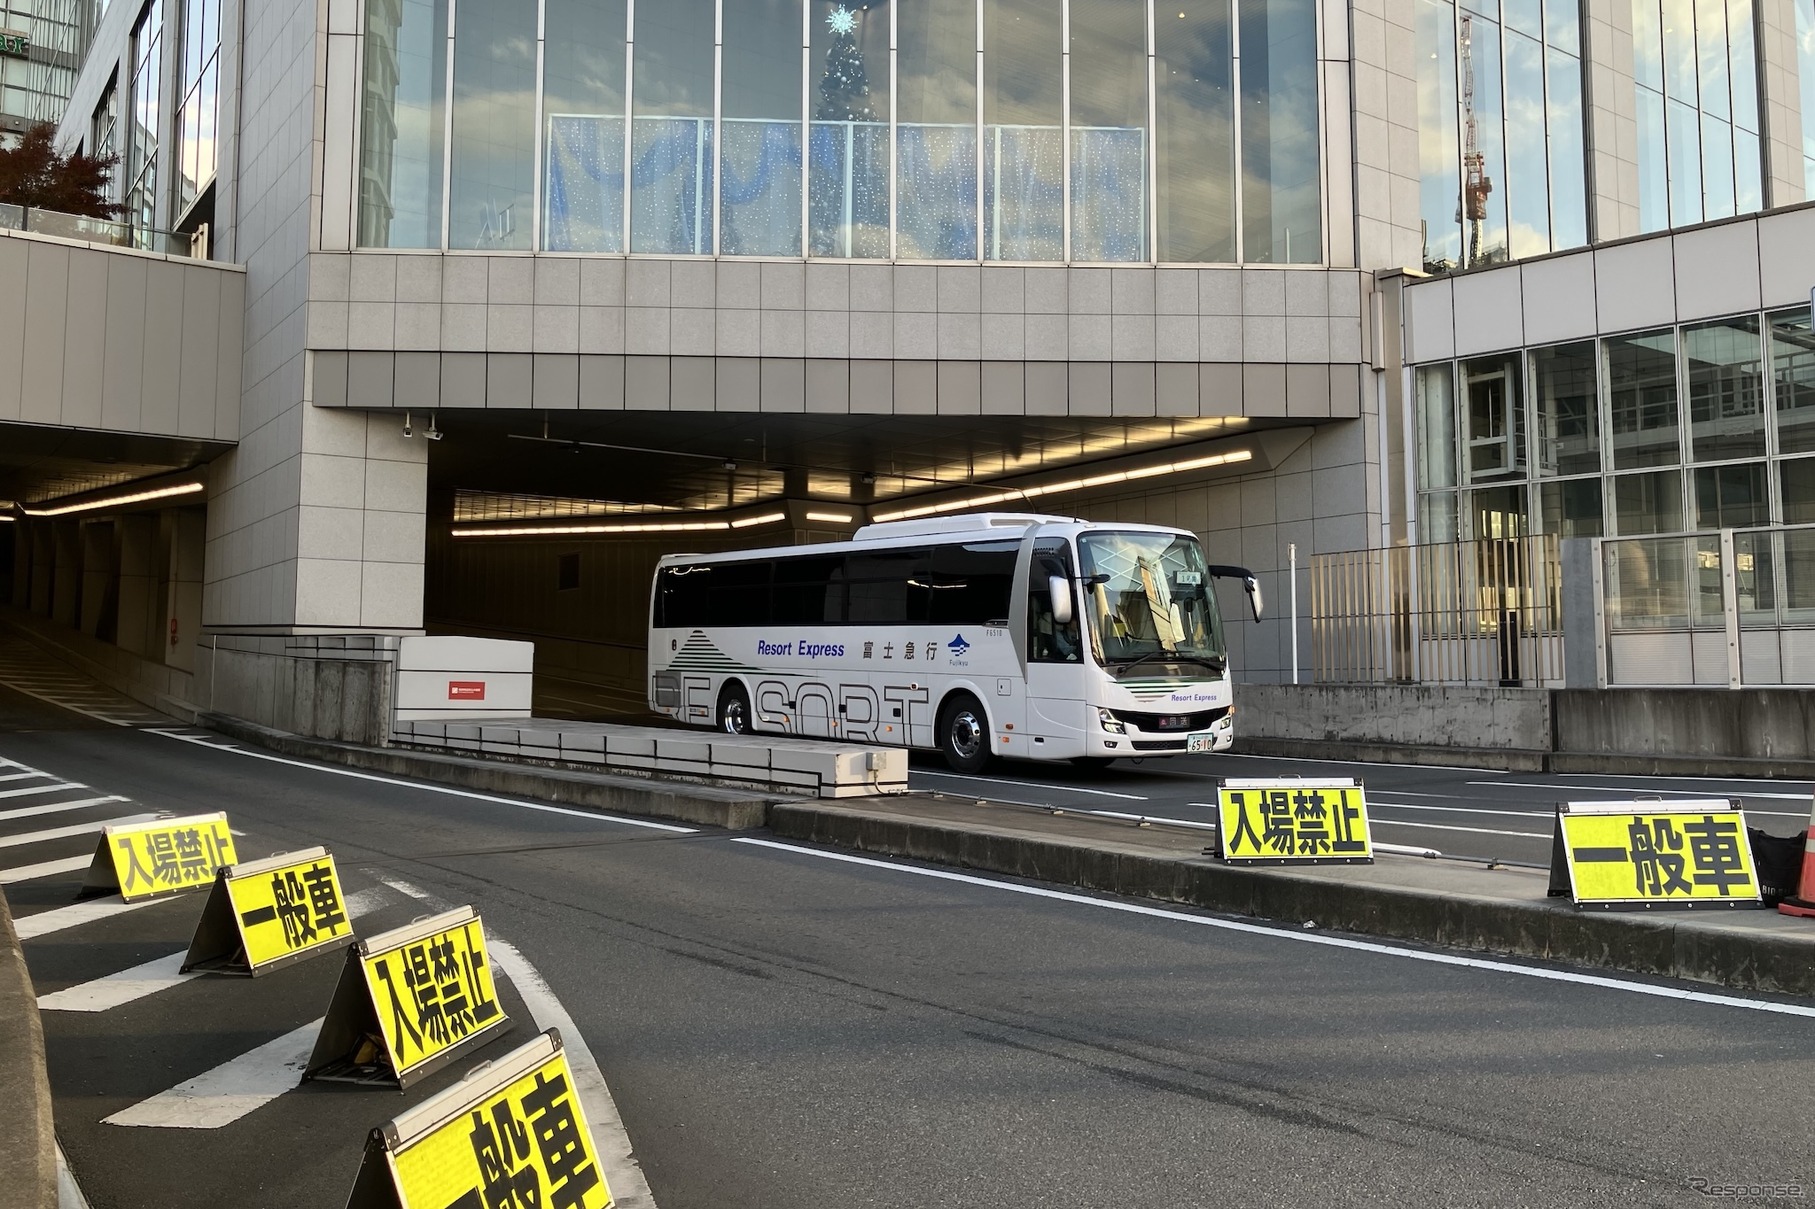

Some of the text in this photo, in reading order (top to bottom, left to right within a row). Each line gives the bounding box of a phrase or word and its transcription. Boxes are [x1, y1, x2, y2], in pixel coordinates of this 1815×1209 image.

[757, 640, 845, 659] Resort Express
[863, 641, 938, 660] 富士急行
[949, 659, 969, 667] Fujikyu
[1171, 693, 1217, 702] Resort Express
[1229, 790, 1366, 855] 入場禁止
[118, 825, 235, 892] 入場禁止
[1573, 816, 1751, 897] 一般車
[241, 864, 346, 950] 一般車
[375, 926, 501, 1066] 入場禁止
